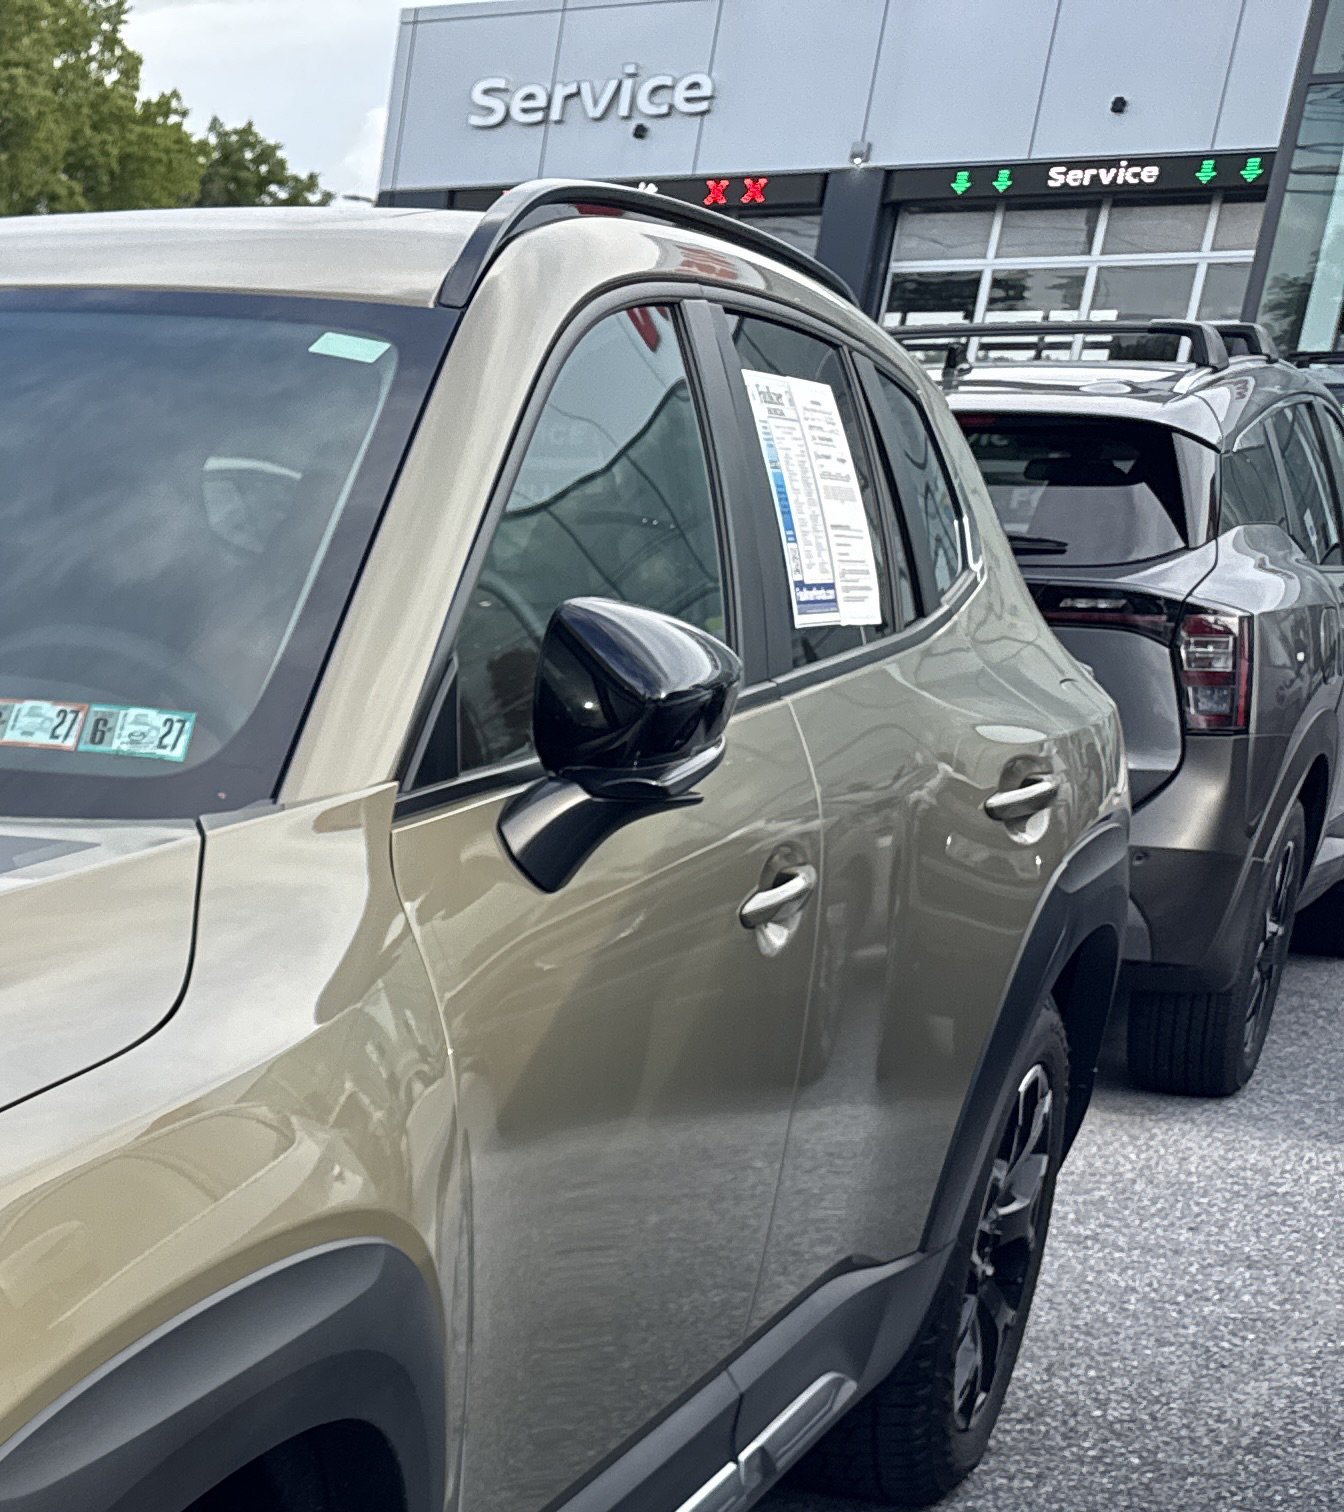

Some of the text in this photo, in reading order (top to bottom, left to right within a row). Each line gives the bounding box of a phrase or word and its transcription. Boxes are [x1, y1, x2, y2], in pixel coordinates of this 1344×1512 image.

[467, 61, 715, 129] Service
[1047, 160, 1160, 188] Service
[49, 709, 81, 744] 27
[157, 717, 187, 751] 27
